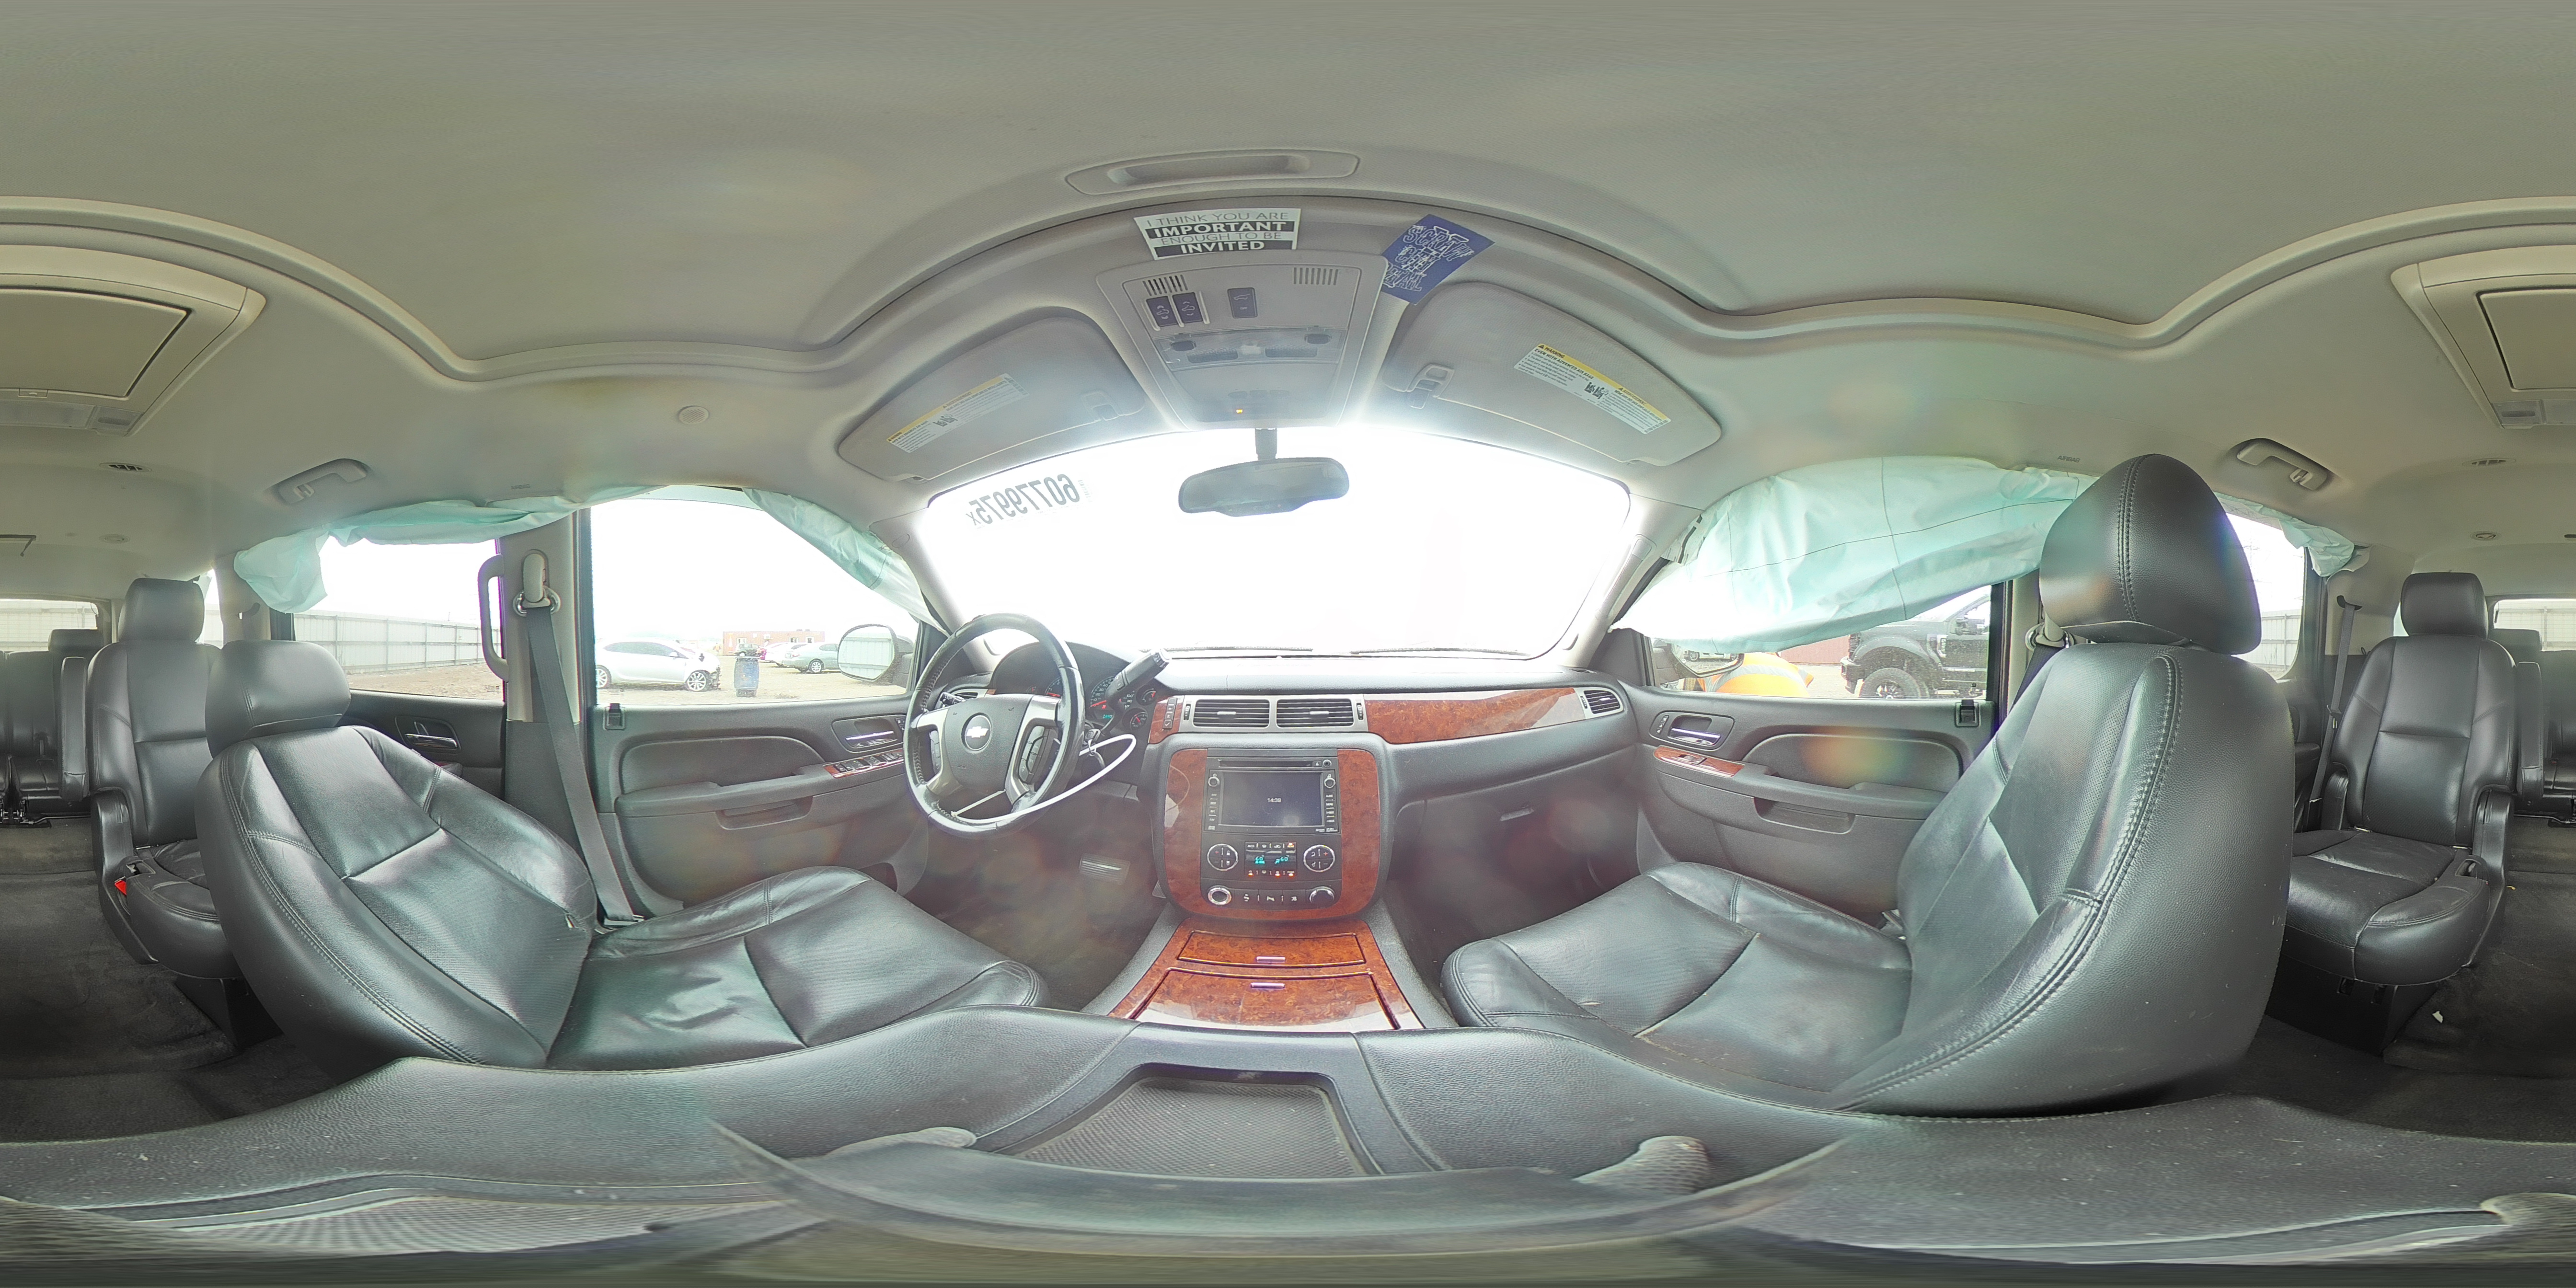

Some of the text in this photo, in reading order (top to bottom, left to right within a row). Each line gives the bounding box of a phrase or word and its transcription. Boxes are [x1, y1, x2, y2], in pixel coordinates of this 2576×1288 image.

[1156, 214, 1208, 226] THINK
[1212, 212, 1250, 220] YOU
[1255, 212, 1289, 220] ARE
[1154, 221, 1287, 238] IMPORTANT
[1161, 233, 1230, 245] ENOUGH
[1180, 241, 1265, 254] INVITED
[1544, 346, 1565, 358] WARNING
